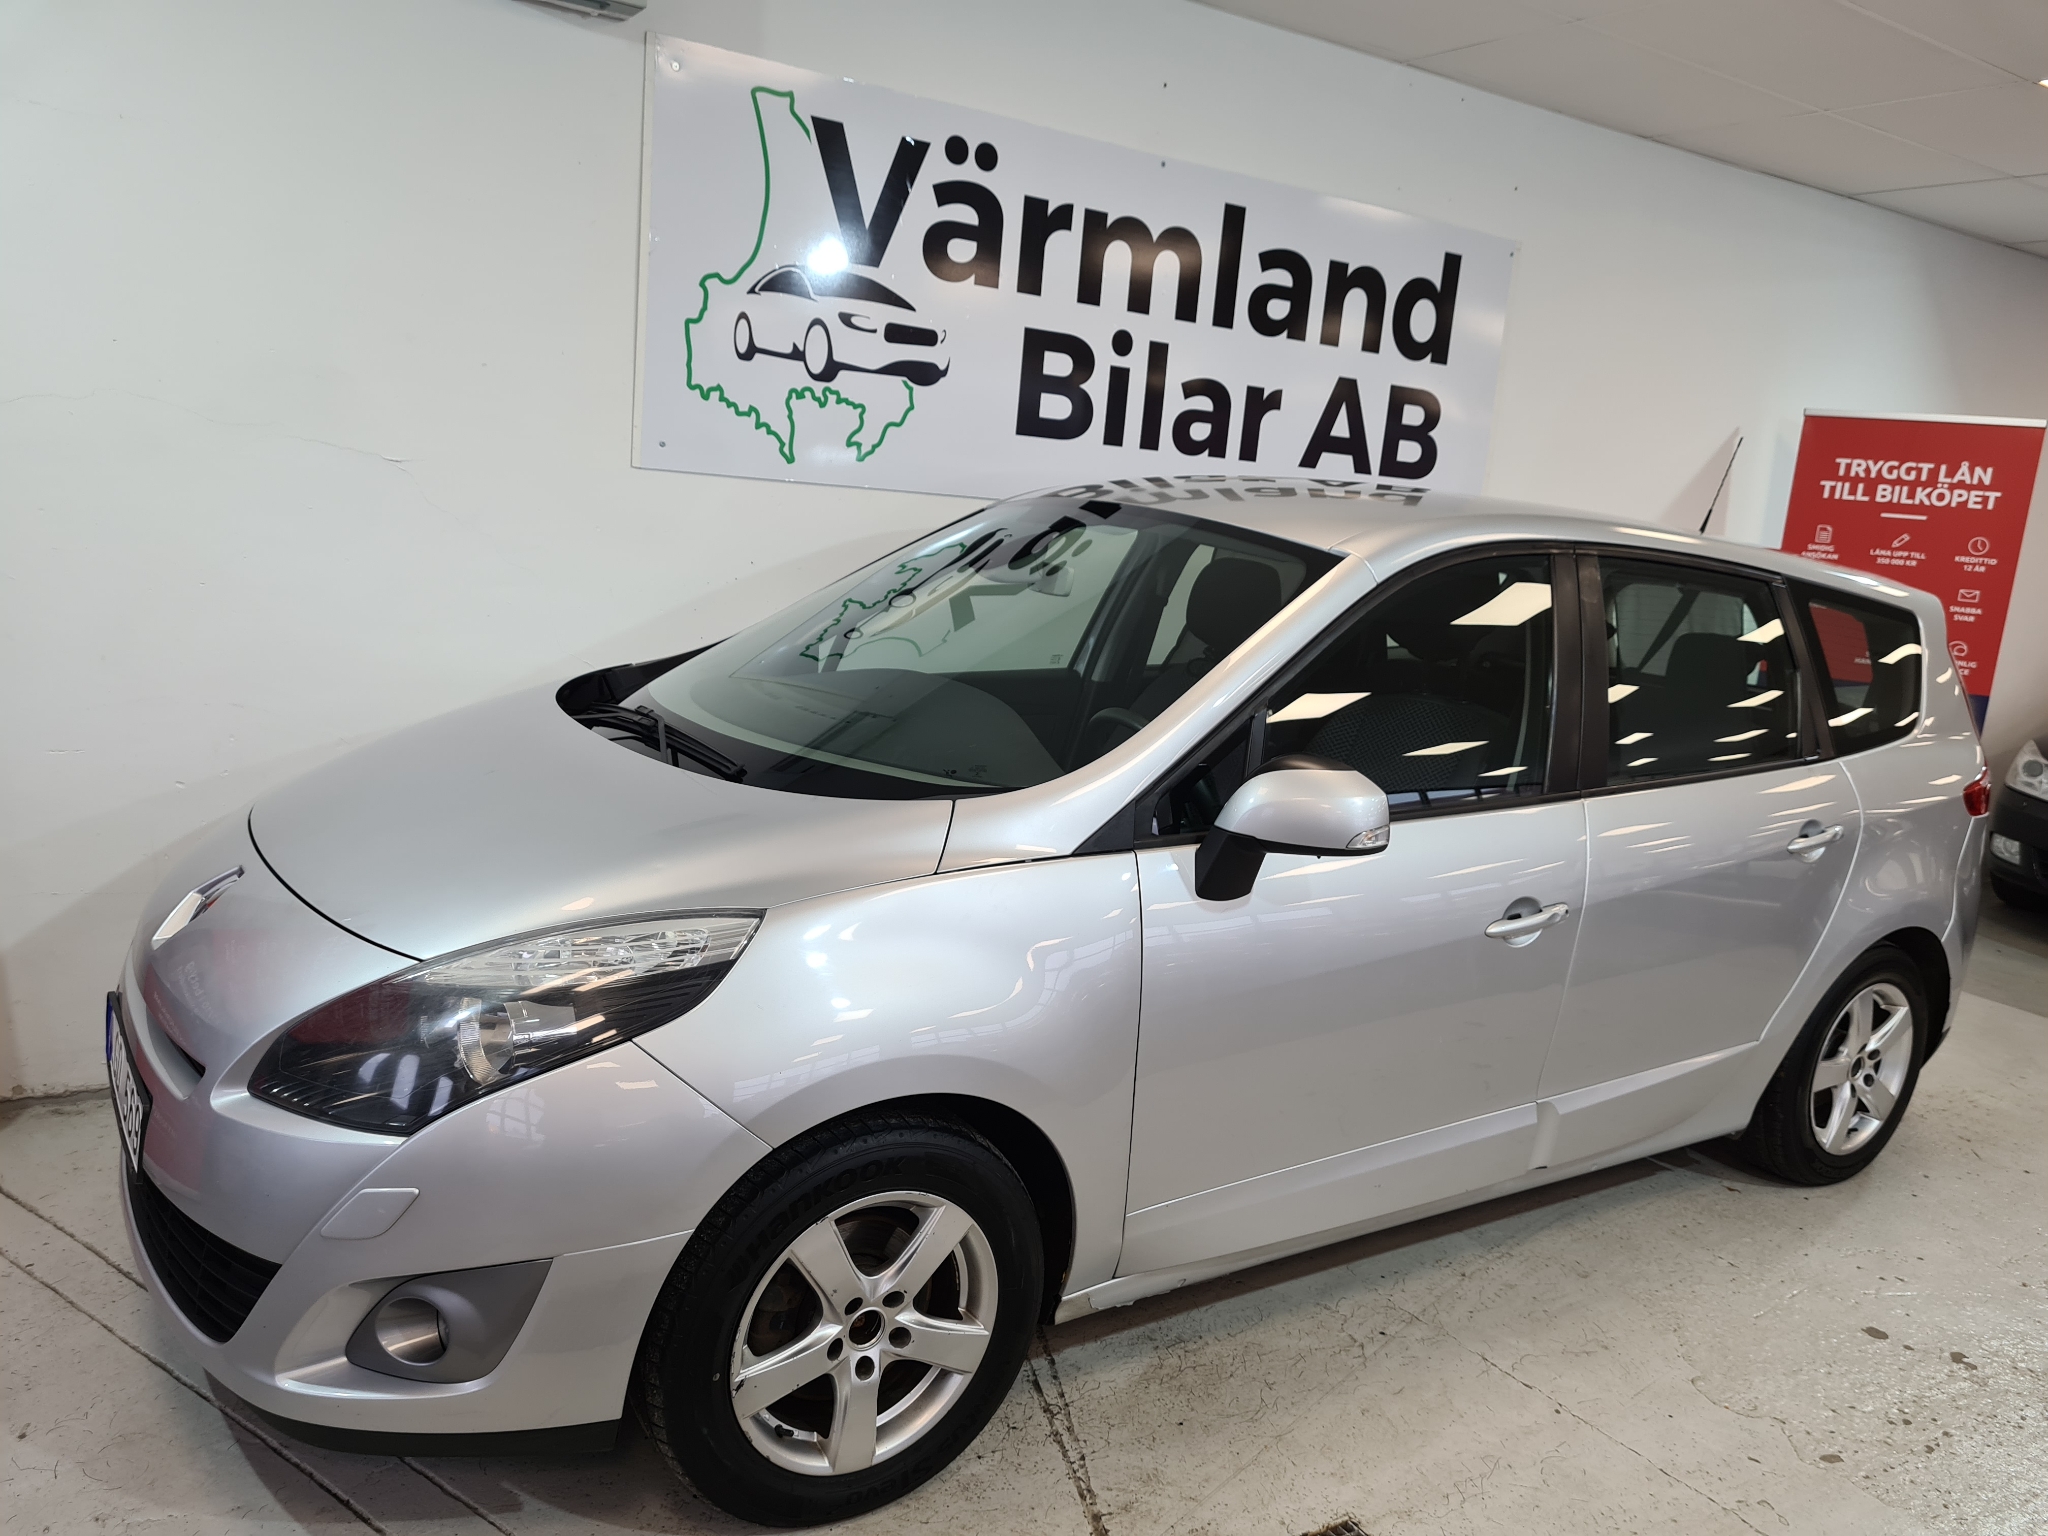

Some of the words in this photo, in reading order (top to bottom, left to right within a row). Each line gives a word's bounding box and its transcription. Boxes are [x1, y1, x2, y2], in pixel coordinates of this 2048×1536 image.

[811, 115, 1461, 365] Värmland
[1016, 327, 1283, 462] Bilar
[1300, 376, 1441, 479] AB
[1835, 458, 1935, 482] TRYGGT
[1938, 461, 1993, 486] LÅN
[1820, 480, 1870, 502] TILL
[1875, 483, 2002, 510] BILKÖPET
[1869, 548, 1892, 557] LÅNA
[1909, 551, 1926, 560] TILL
[1905, 559, 1918, 567] KR
[1954, 555, 1998, 566] KREDITTID
[1963, 564, 1973, 572] 12
[1949, 605, 1982, 615] SNABBA
[1953, 614, 1976, 622] SVAR
